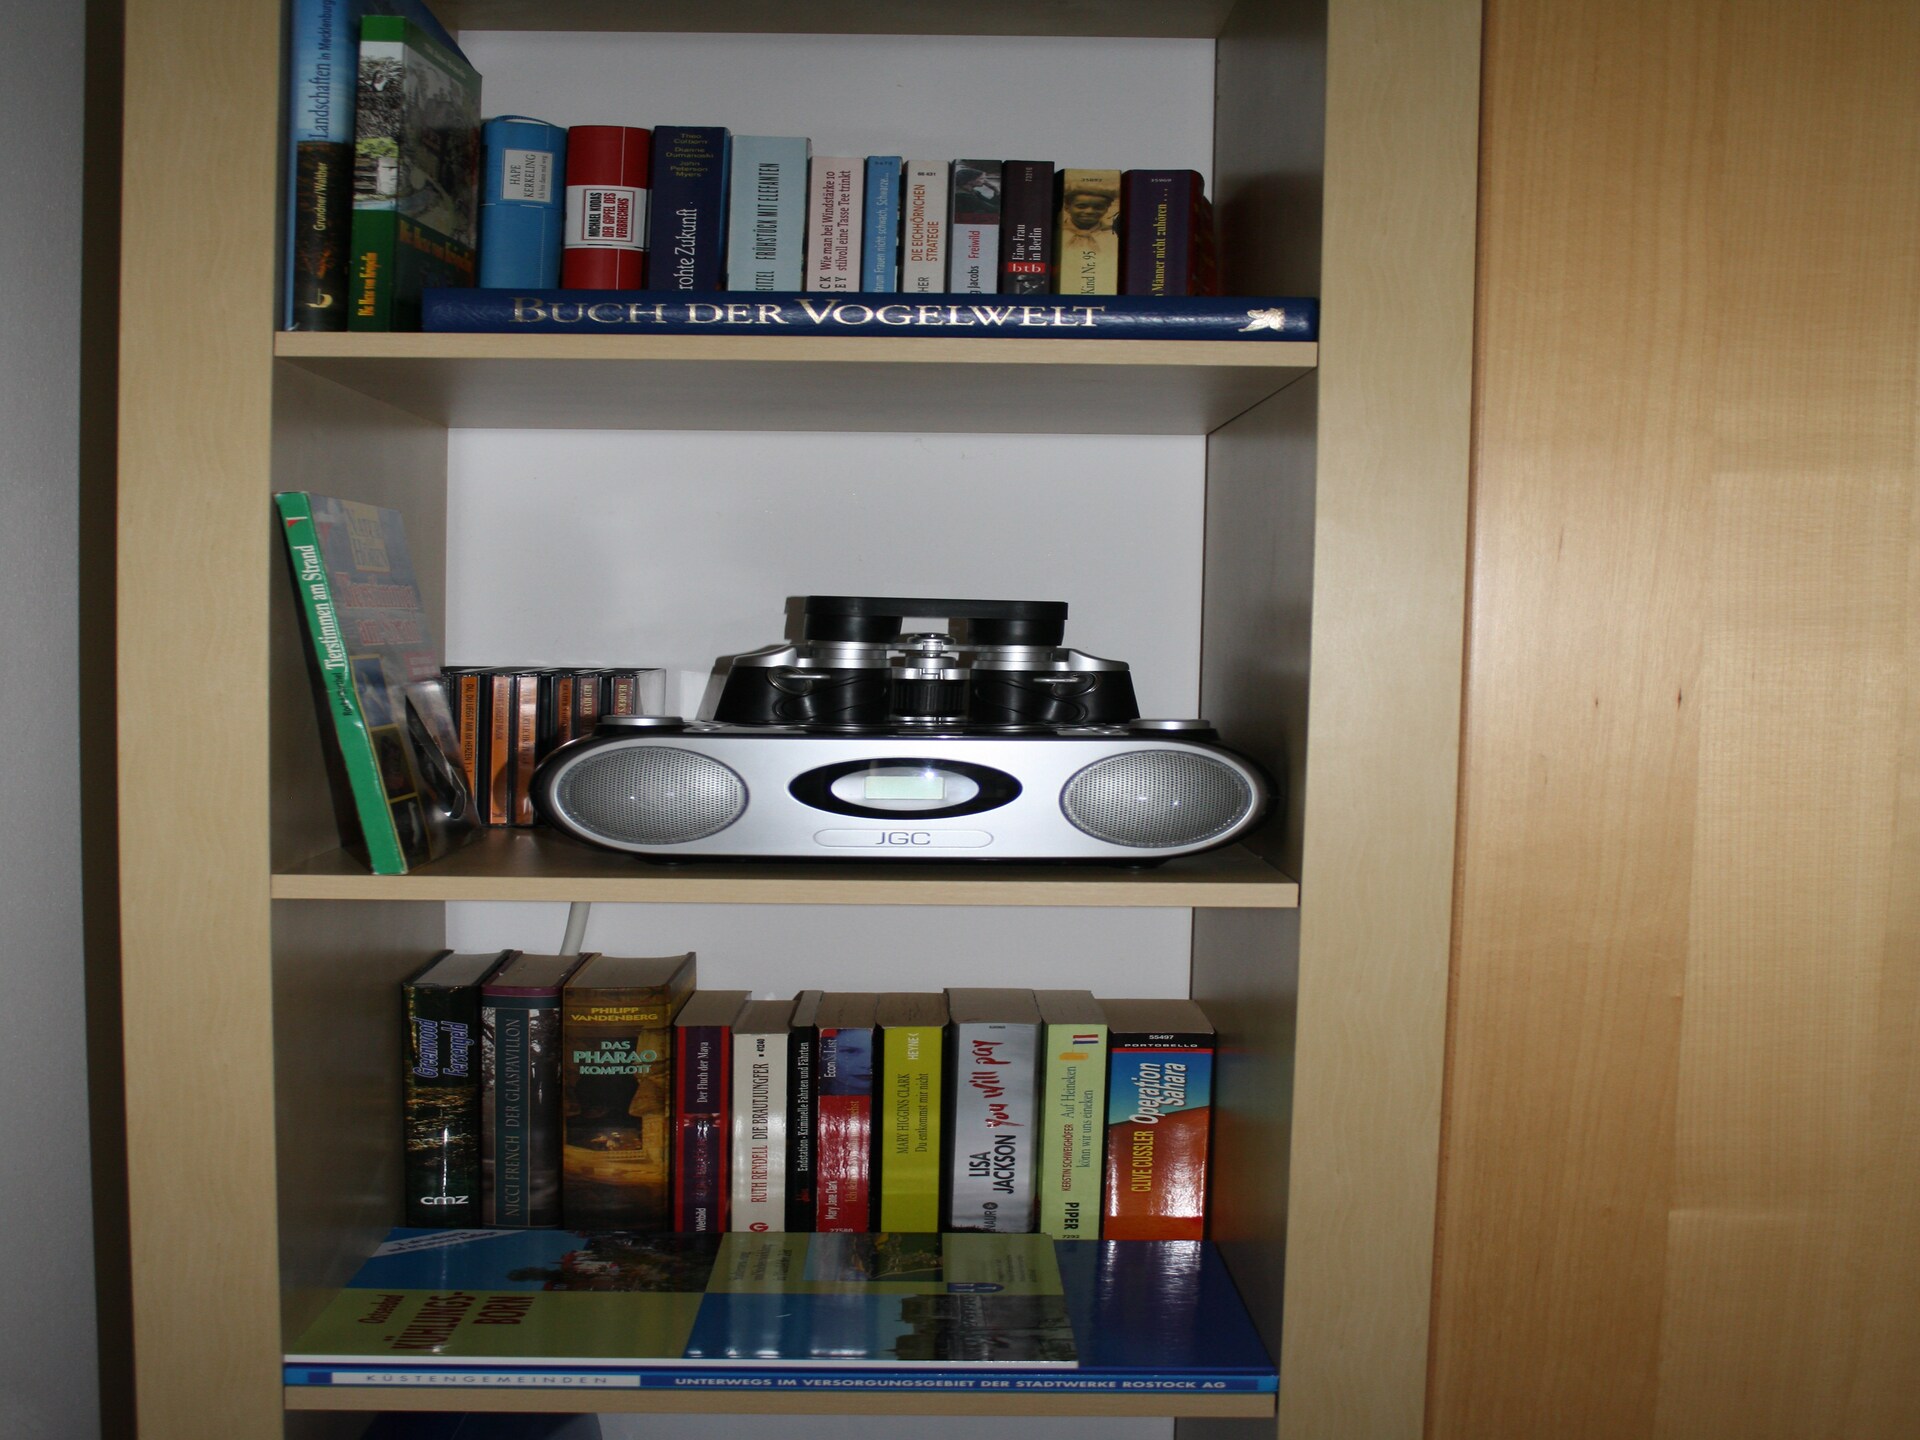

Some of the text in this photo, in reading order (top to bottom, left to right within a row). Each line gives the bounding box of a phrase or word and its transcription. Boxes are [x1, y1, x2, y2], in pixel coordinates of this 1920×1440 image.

[308, 63, 331, 139] Landschaften
[510, 165, 521, 186] HAPE
[524, 154, 536, 198] KERKELING
[757, 163, 780, 201] ELEFANTEN
[604, 192, 616, 204] DES
[757, 204, 778, 217] MIT
[589, 192, 602, 238] MICHAEL KODAS
[603, 205, 615, 225] GIPFEL
[616, 198, 629, 238] VERBRECHENS
[820, 171, 835, 271] Wie man bei Windstärke 10
[835, 170, 851, 271] stilvoll eine Tasse Tee trinkt
[910, 184, 926, 246] EICHHÖRNCHEN
[673, 208, 697, 291] rohte Zukunft
[752, 219, 778, 260] FRÜHSTÜCK
[875, 236, 886, 252] nicht
[911, 247, 923, 262] DIE
[926, 221, 939, 262] STRATEGIE
[968, 230, 980, 259] Freiwild
[1012, 224, 1026, 261] Eine Frau
[1028, 227, 1042, 261] in Berlin
[1152, 238, 1166, 258] nicht
[874, 252, 886, 273] Frauen
[967, 265, 980, 288] Jacobs
[1012, 263, 1042, 272] btb
[1081, 250, 1097, 295] Kind Nr. 95
[1152, 261, 1167, 292] Männer
[508, 297, 1105, 328] BUCH DER VOGELWELT
[294, 544, 321, 581] Strand
[310, 583, 327, 601] am
[315, 603, 347, 670] Tierstimmen
[875, 831, 931, 846] JGC
[571, 1014, 658, 1022] VANDENBERG
[413, 1017, 439, 1079] Greenwood
[573, 1049, 658, 1064] PHARAO
[601, 1041, 631, 1050] DAS
[824, 1039, 838, 1053] List
[908, 1037, 919, 1061] HEYNE
[579, 1065, 652, 1075] KOMPLOTT
[696, 1041, 712, 1103] Der Fluch der Maya
[824, 1061, 836, 1078] Econ
[1160, 1062, 1187, 1107] Sahara
[505, 1018, 521, 1217] NICCI FRENCH DER GLASPAVILLON
[797, 1042, 809, 1172] Endstation Kriminelle Fahrten und Fährten
[896, 1073, 910, 1154] MARY HIGGINS CLARK
[915, 1073, 929, 1153] Du entkommst mir nicht
[1078, 1090, 1094, 1119] eineken
[751, 1063, 769, 1203] RUTH RENDELL DIE BRAUTJUNGFER
[1060, 1066, 1077, 1192] KERSTIN SCHWEIGHÖFER Auf Heineken
[1078, 1135, 1091, 1147] wir
[1082, 1119, 1092, 1134] uns
[1129, 1062, 1165, 1193] CLIVE CUSSLER Operation
[969, 1151, 991, 1177] LISA
[993, 1134, 1017, 1194] JACKSON
[825, 1179, 840, 1220] Mary Jane Clark
[1064, 1202, 1080, 1230] PIPER
[358, 1293, 405, 1325] Ostseebad
[384, 1291, 478, 1351] KÜHLUNGS-
[472, 1295, 537, 1326] BORN
[366, 1373, 607, 1385] KÜSTENGEMEINDEN
[675, 1377, 1227, 1389] UNTERWEGS IM VERSORGUNGSGEBIET DER STADTWERKE ROSTOCK AG
